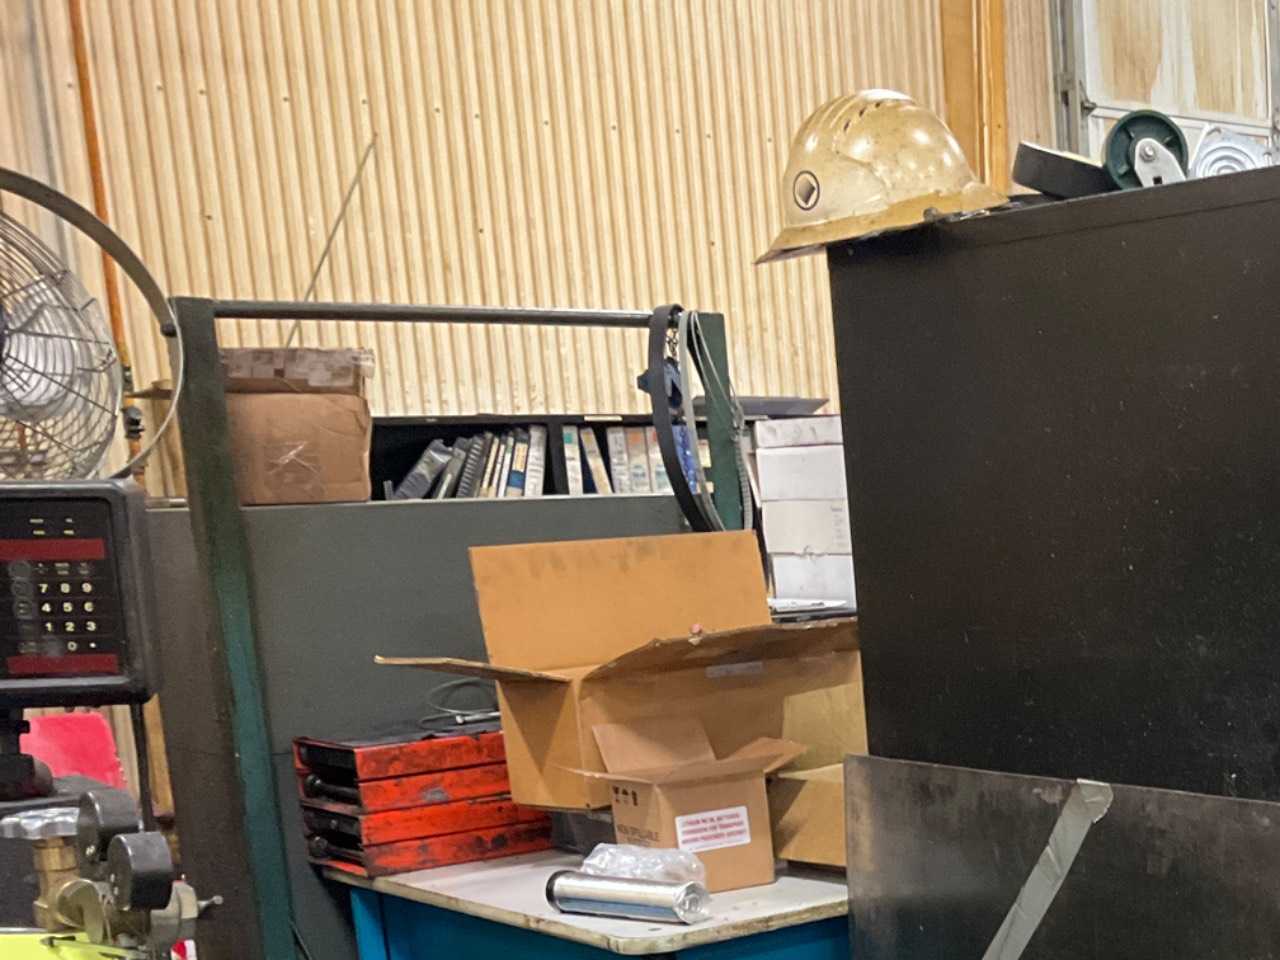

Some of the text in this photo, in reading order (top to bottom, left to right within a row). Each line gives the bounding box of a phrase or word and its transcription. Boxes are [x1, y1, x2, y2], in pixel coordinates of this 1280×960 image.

[38, 583, 48, 593] 7
[41, 603, 51, 613] 4
[63, 602, 73, 612] 5
[45, 621, 96, 632] 1 2 3
